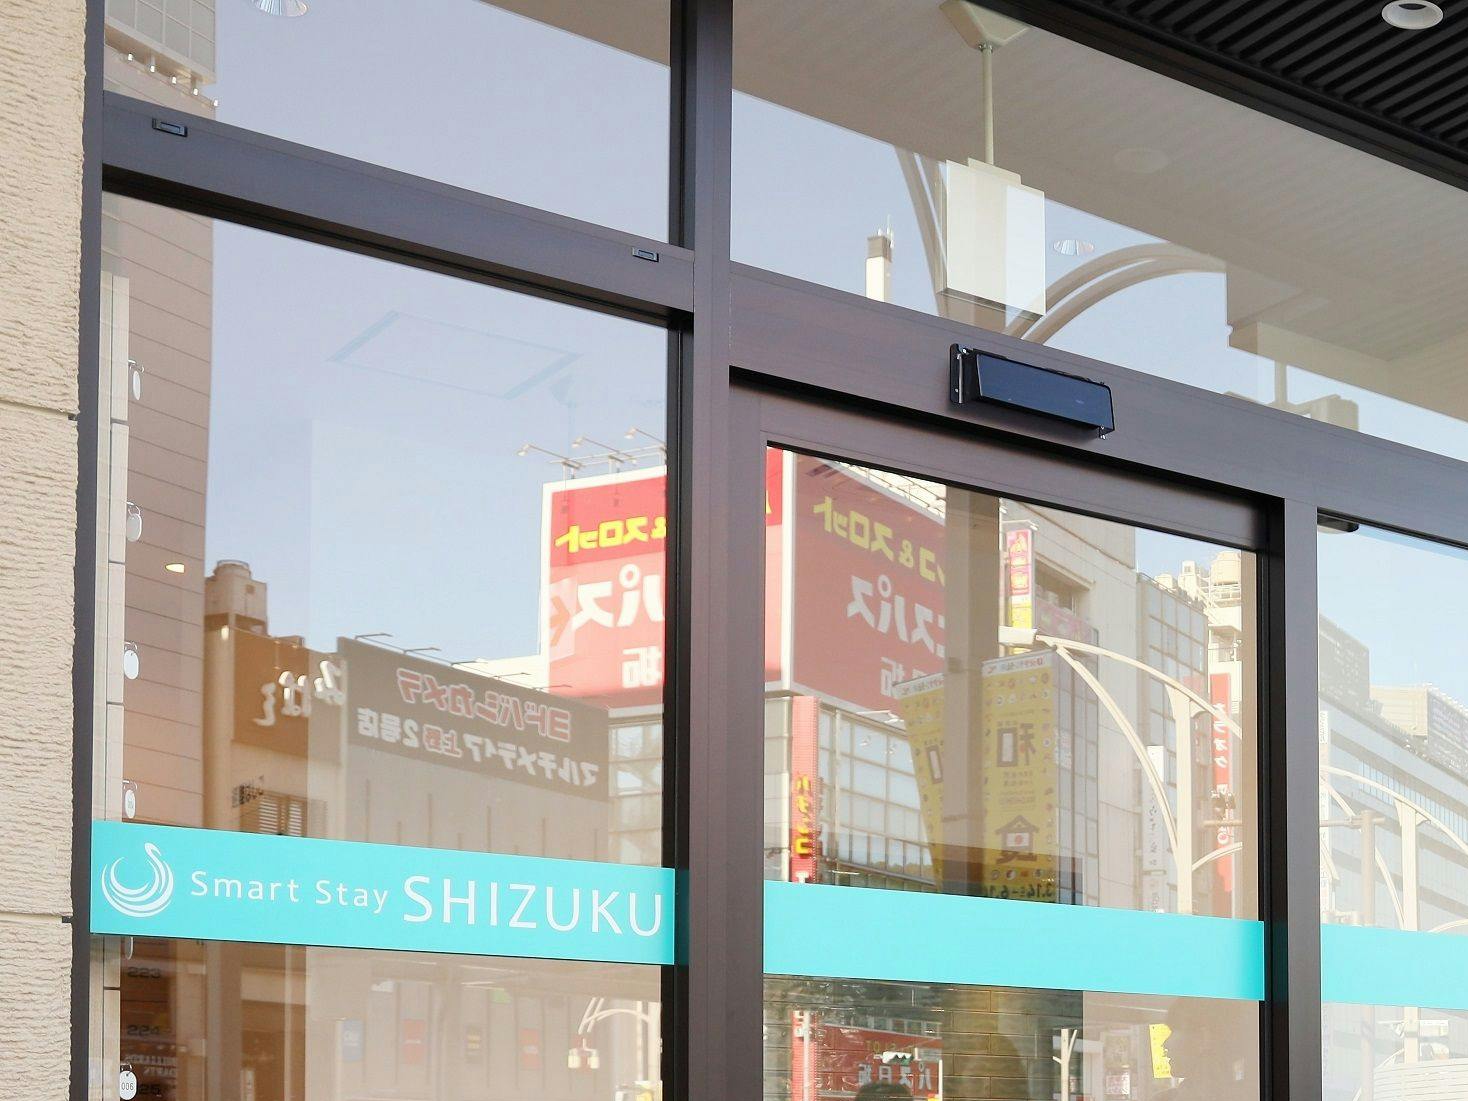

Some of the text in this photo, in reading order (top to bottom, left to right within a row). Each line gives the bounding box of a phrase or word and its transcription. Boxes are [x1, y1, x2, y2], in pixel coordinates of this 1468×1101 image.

[190, 870, 664, 938] Smart Stay SHIZUKU
[121, 1081, 135, 1092] 006
